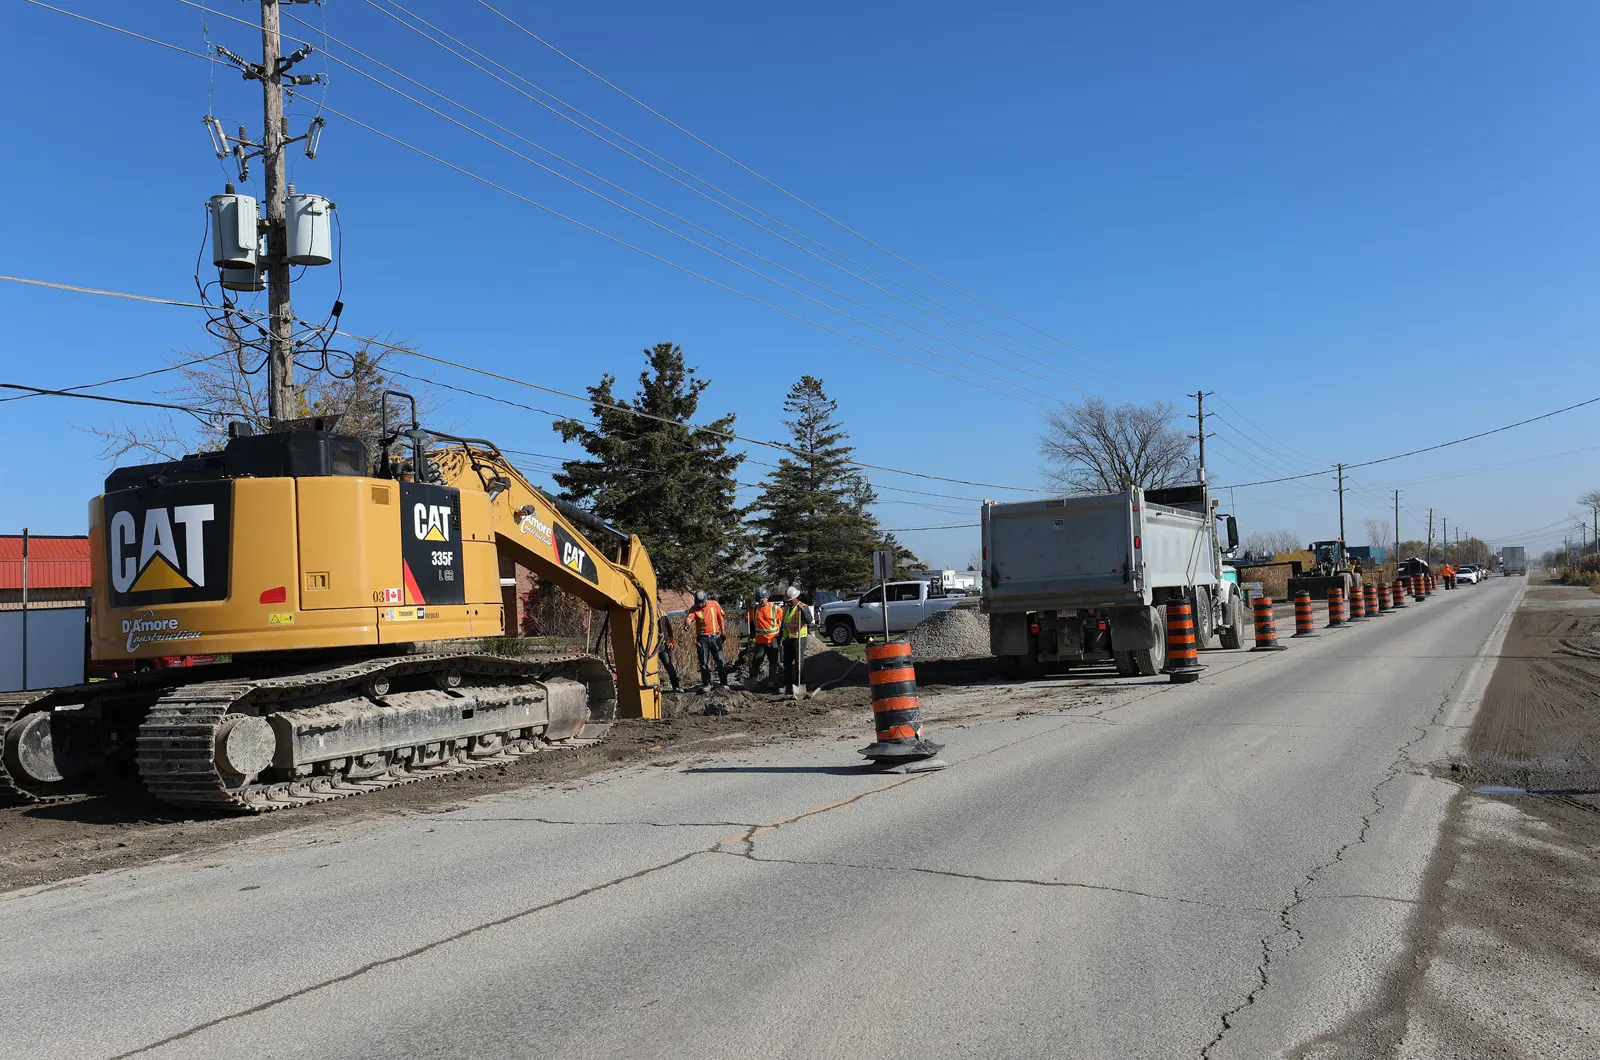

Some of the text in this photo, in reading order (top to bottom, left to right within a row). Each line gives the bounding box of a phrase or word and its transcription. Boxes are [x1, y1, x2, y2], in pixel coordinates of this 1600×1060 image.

[414, 503, 451, 542] CAT
[111, 504, 214, 593] CAT
[431, 551, 453, 566] 335F
[563, 541, 585, 573] CAT
[372, 590, 384, 602] 03
[122, 618, 179, 633] D'Amore
[126, 629, 202, 653] Construction
